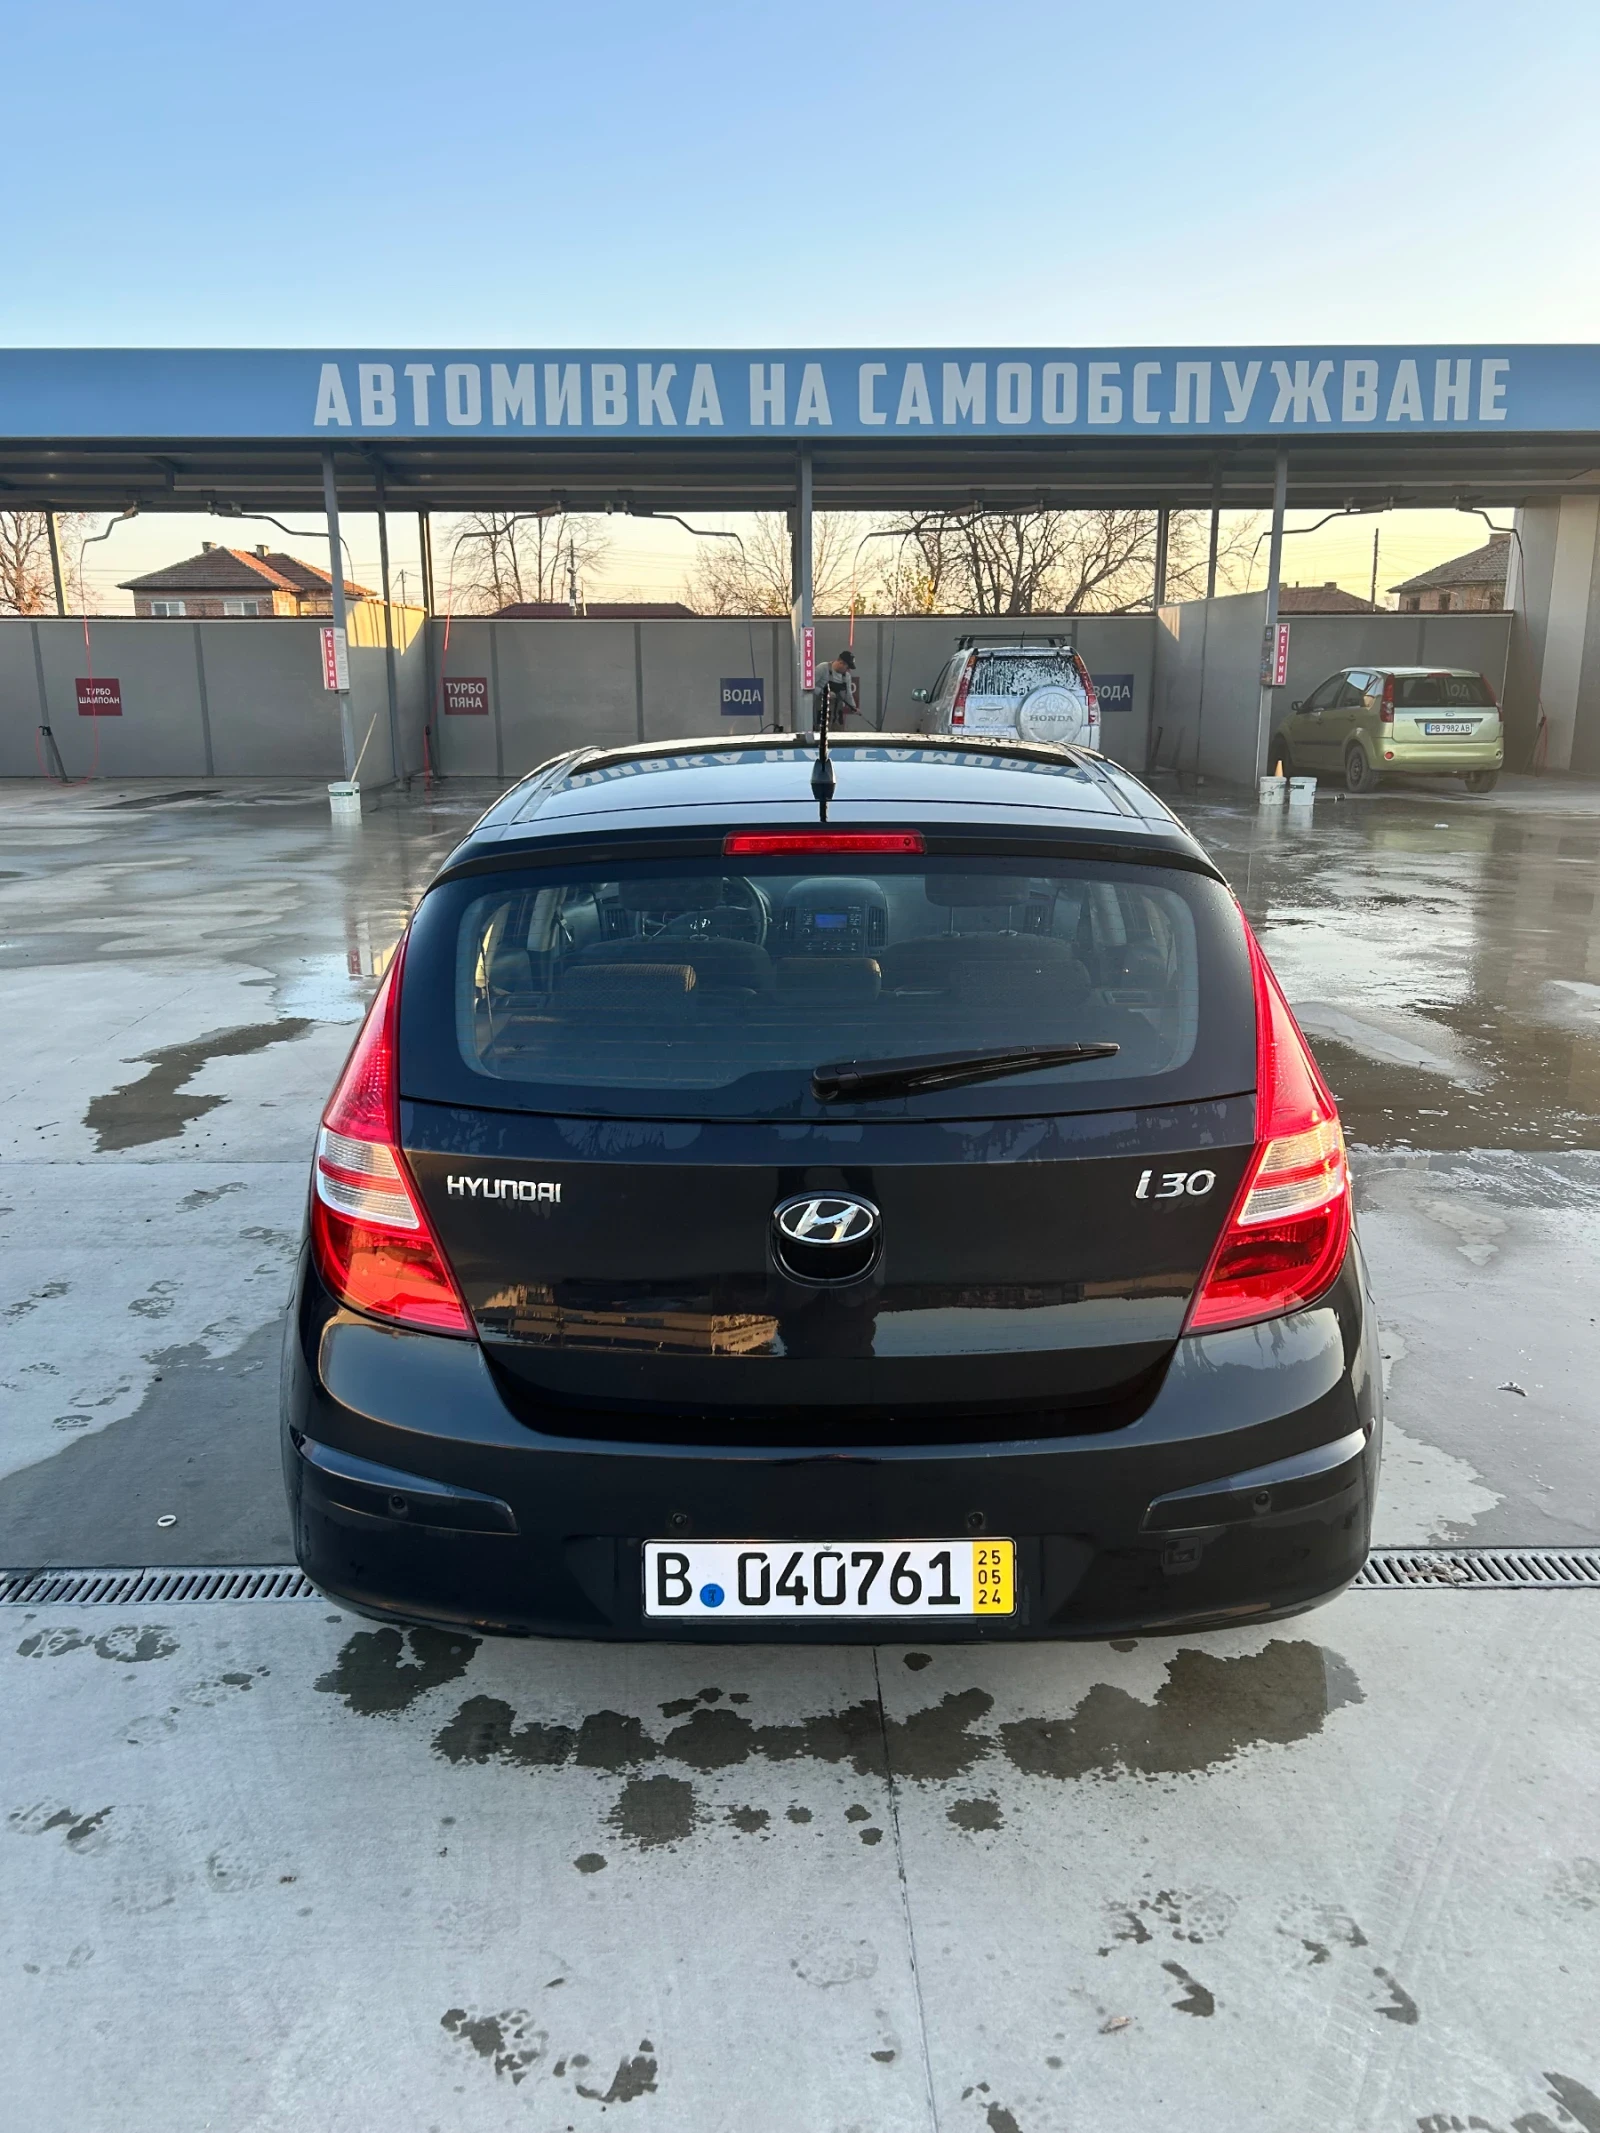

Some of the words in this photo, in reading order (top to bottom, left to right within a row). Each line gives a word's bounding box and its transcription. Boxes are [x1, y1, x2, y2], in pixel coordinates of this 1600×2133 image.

[313, 363, 725, 427] АВТОМИВКА
[749, 362, 834, 426] НА
[858, 358, 1511, 426] САМООБСЛУЖВАНЕ
[325, 630, 336, 687] ЖЕТОНИ
[805, 629, 813, 687] ЖЕТОНИ
[1277, 626, 1288, 683] ЖЕТОНИ
[86, 687, 111, 696] ТУРБО
[445, 682, 485, 695] ТУРБО
[723, 689, 762, 705] ВОДА
[1093, 685, 1131, 702] ВОДА
[79, 696, 120, 704] ШАМПОАН
[449, 696, 483, 708] ПЯНА
[446, 1175, 562, 1203] HYUNDAI
[978, 1549, 1002, 1566] 25
[656, 1552, 693, 1606] B
[737, 1551, 961, 1606] 040761
[978, 1569, 1002, 1585] 05
[978, 1588, 1002, 1605] 24
